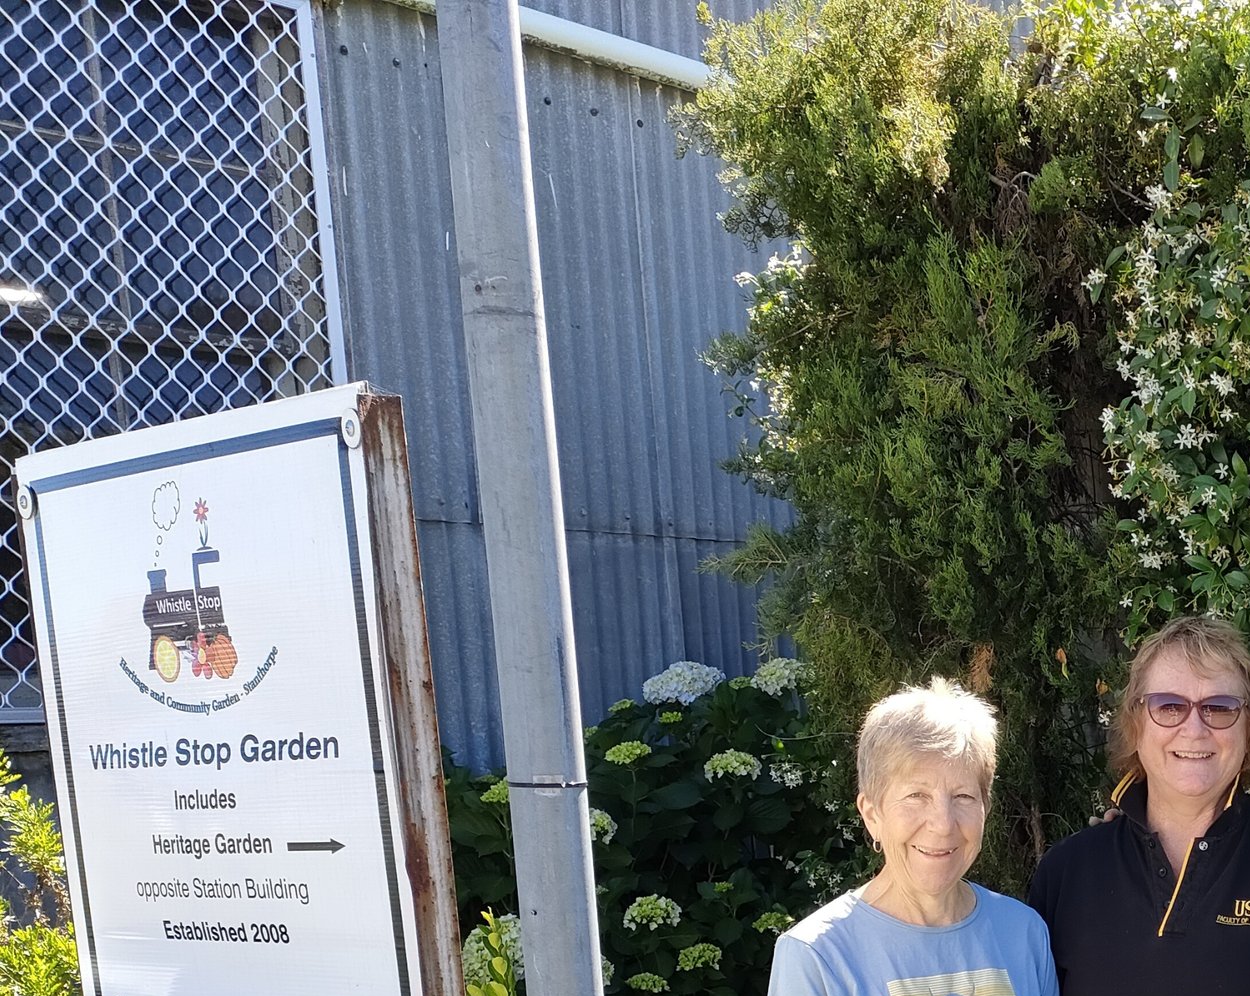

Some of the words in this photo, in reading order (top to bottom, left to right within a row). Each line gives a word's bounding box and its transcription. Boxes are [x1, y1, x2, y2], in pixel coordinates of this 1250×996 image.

[156, 594, 191, 613] Whistle
[198, 594, 221, 612] Stop
[119, 656, 149, 694] Heritage
[150, 688, 165, 705] and
[166, 697, 211, 716] Community
[212, 693, 240, 712] Garden
[243, 645, 279, 696] Stanthorpe
[89, 741, 167, 770] Whistle
[175, 738, 231, 770] Stop
[240, 732, 340, 763] Garden
[174, 789, 237, 810] Includes
[152, 834, 211, 859] Heritage
[214, 833, 273, 854] Garden
[136, 878, 190, 902] opposite
[192, 877, 242, 899] Station
[245, 878, 310, 905] Building
[163, 920, 248, 942] Established
[250, 923, 290, 944] 2008
